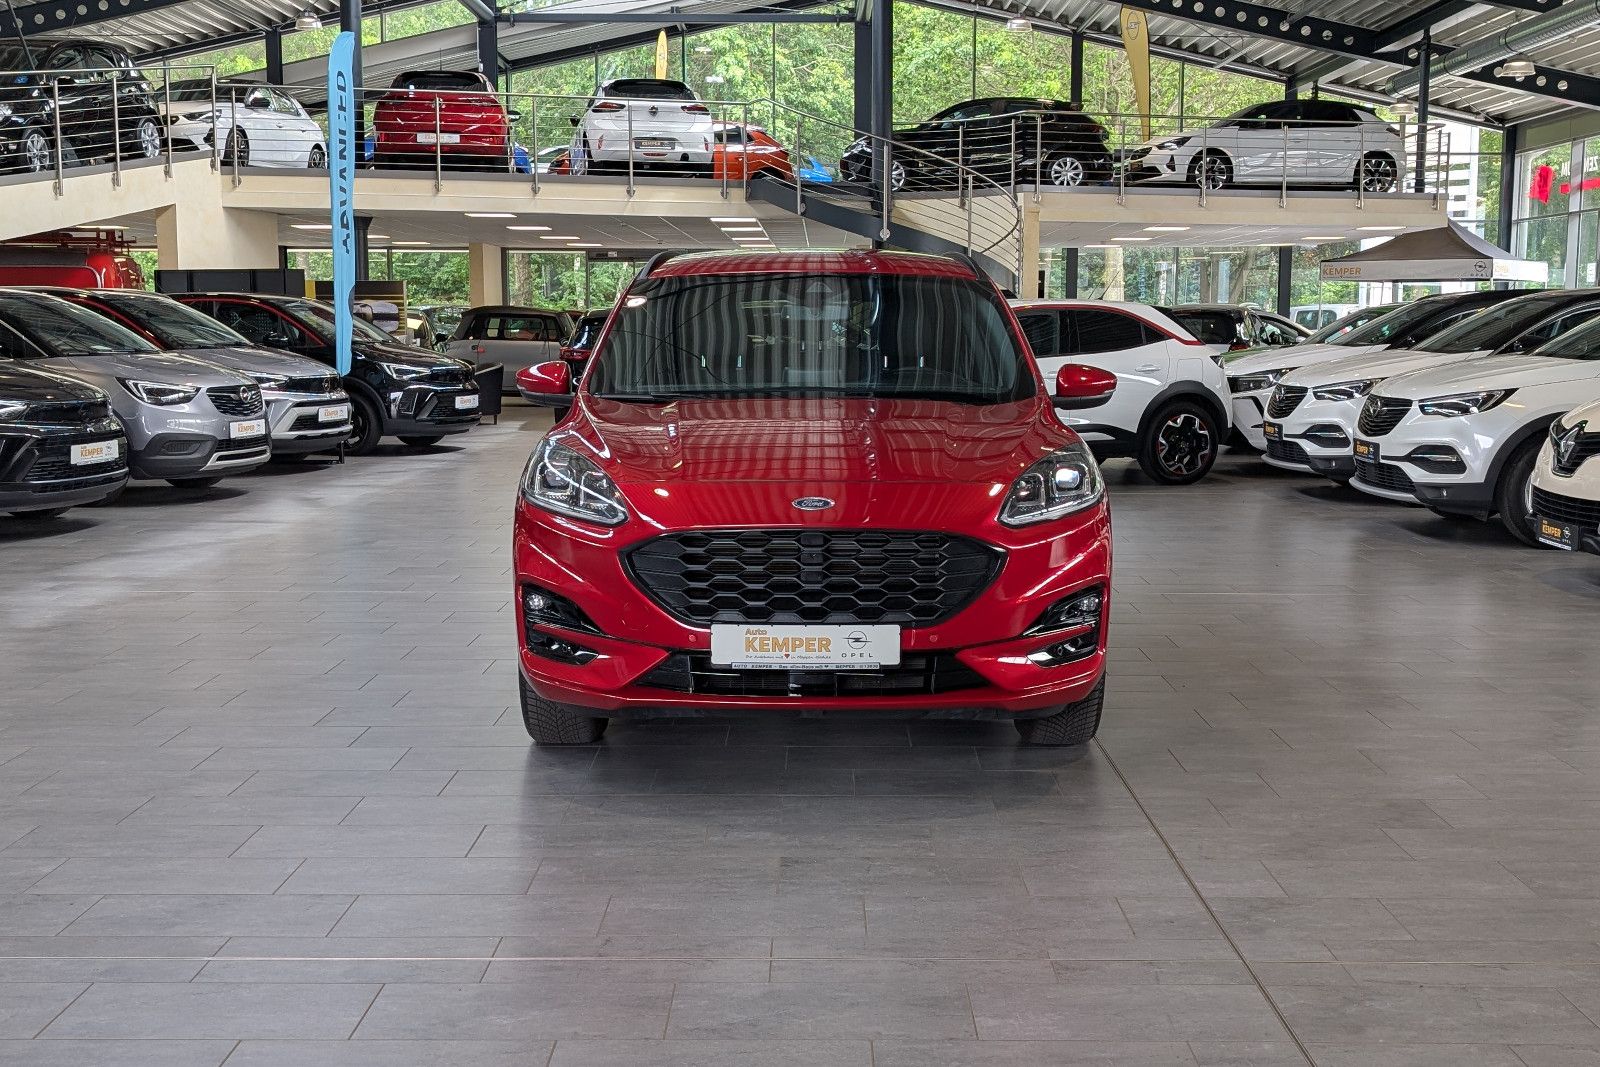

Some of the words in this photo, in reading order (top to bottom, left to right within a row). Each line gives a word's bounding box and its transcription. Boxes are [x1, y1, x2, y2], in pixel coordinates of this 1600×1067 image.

[1322, 267, 1361, 276] KEMPER
[80, 447, 103, 457] KEMPER
[1542, 524, 1561, 538] KEMPER
[745, 628, 767, 636] Auto
[745, 637, 832, 652] KEMPER
